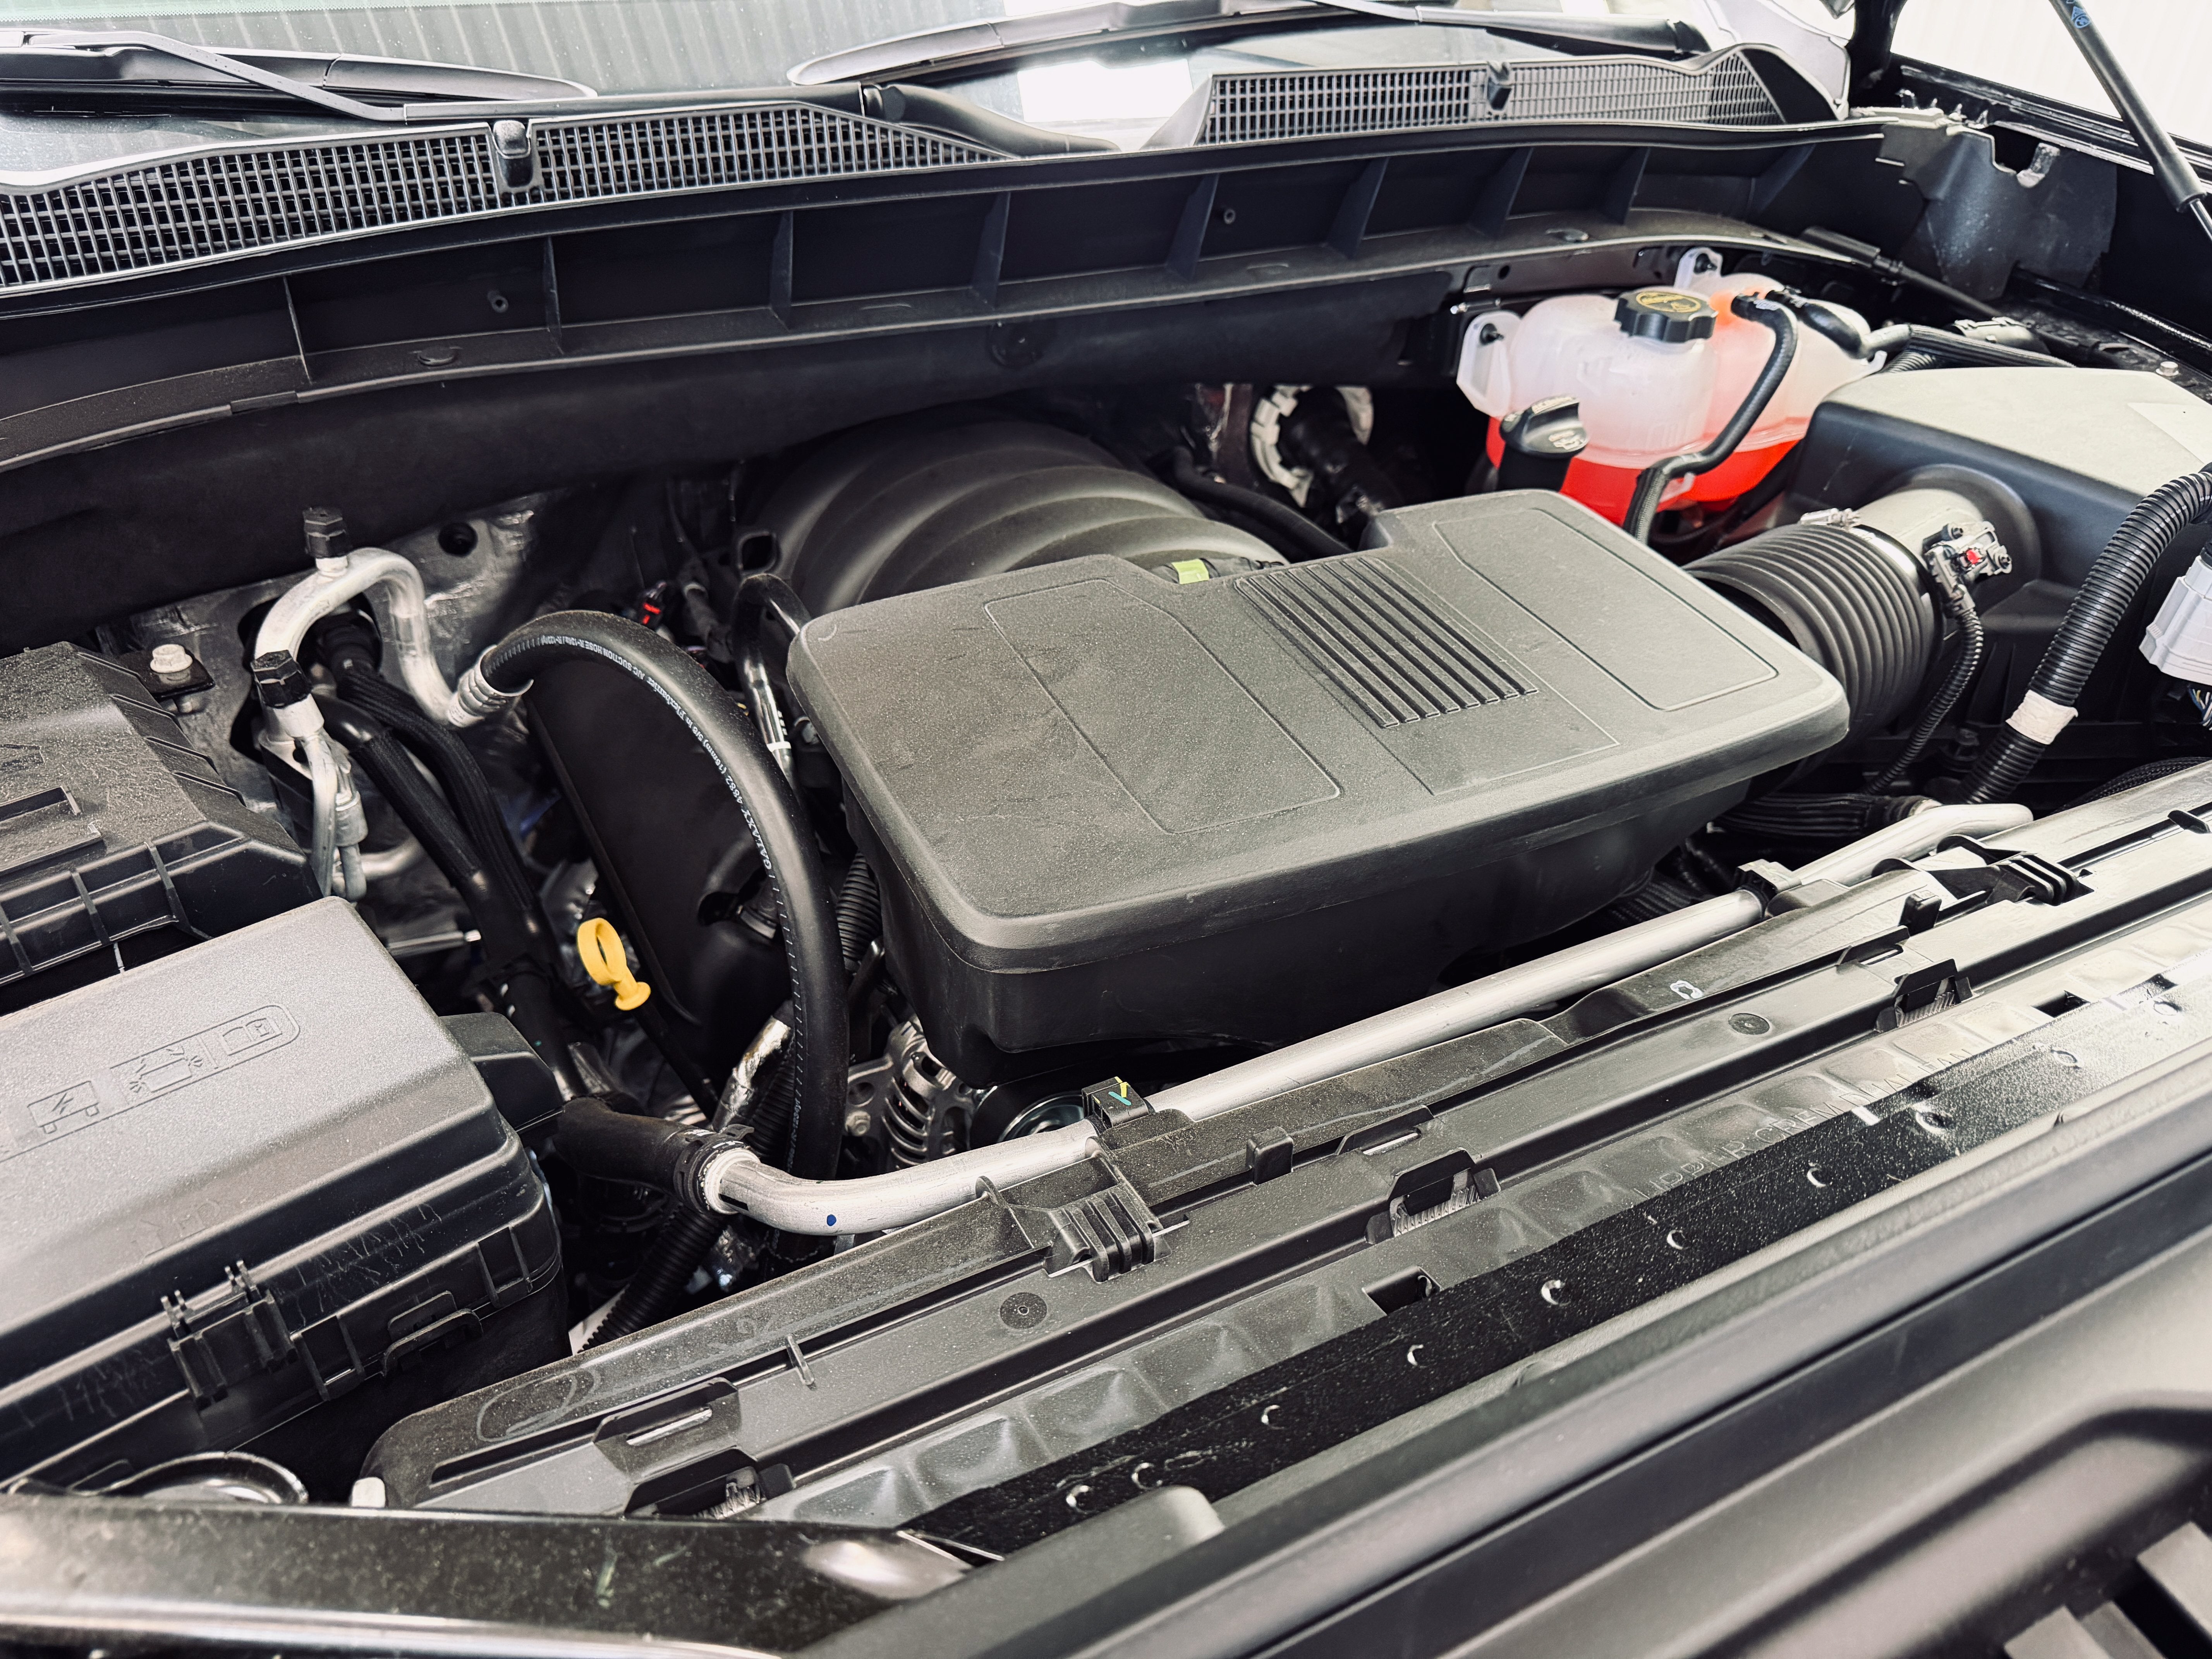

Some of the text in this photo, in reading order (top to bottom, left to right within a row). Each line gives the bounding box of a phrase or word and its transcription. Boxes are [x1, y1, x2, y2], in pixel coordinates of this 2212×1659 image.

[584, 640, 603, 655] HOSE
[603, 647, 632, 671] SUCTION
[632, 666, 645, 680] A/C
[692, 726, 704, 742] 5/8
[702, 739, 727, 774] (16mm)
[725, 775, 743, 804] 4882
[740, 808, 772, 870] GALAXY
